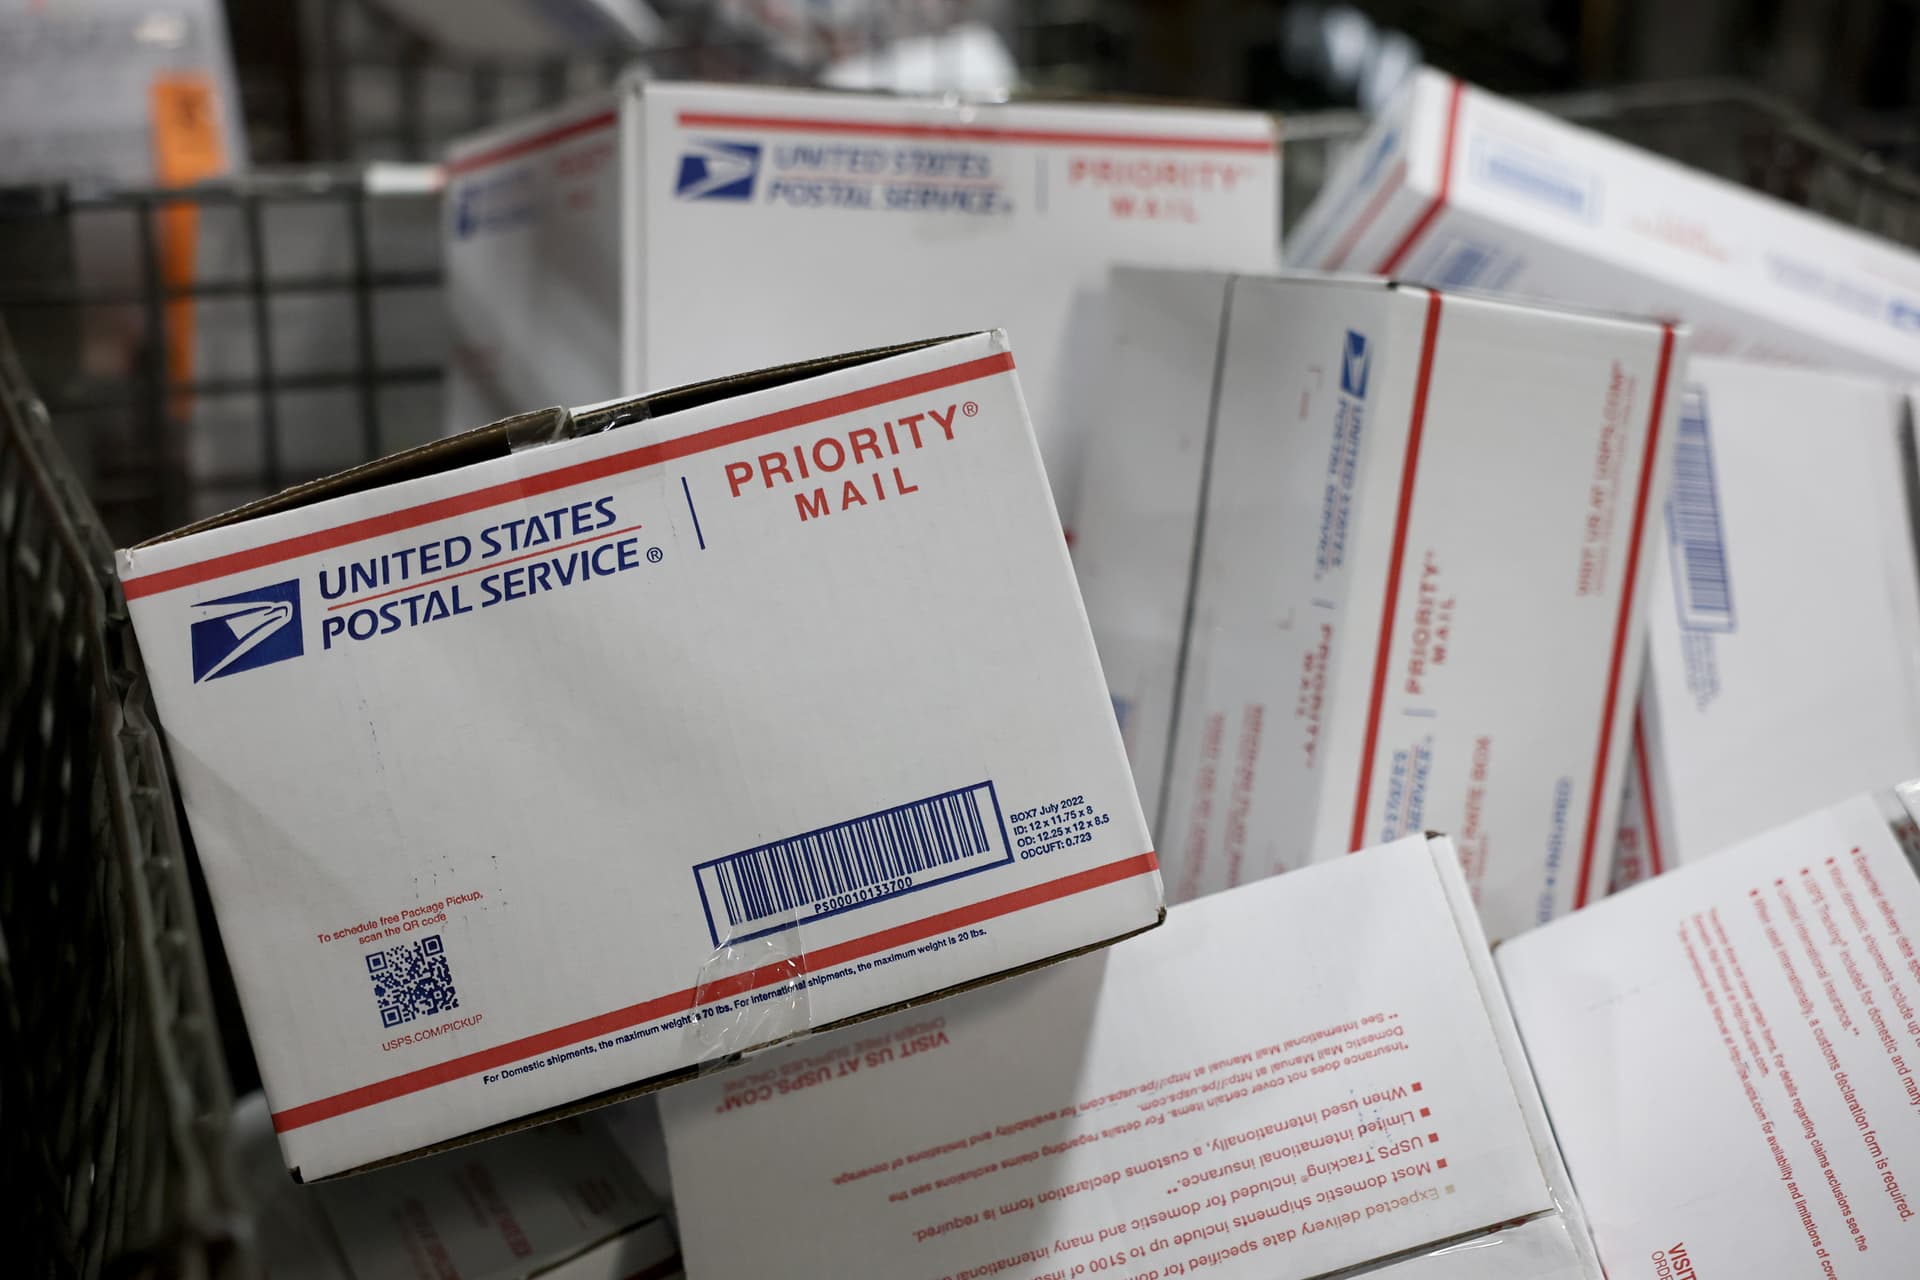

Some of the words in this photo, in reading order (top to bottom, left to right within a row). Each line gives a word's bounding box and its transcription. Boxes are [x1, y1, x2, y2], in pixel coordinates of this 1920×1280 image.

[1069, 157, 1257, 190] PRIORITY
[885, 186, 1016, 216] SERVICE
[724, 401, 978, 498] PRIORITY®
[794, 467, 919, 522] MAIL
[319, 535, 472, 600] UNITED
[480, 496, 617, 560] STATES
[322, 592, 473, 650] POSTAL
[480, 537, 663, 608] SERVICE®
[1406, 549, 1438, 694] PRIORITY
[1010, 808, 1037, 823] BOX7
[1040, 804, 1059, 815] July
[1061, 795, 1084, 809] 2022
[1014, 826, 1028, 836] ID:
[1029, 821, 1042, 831] 12
[1051, 810, 1077, 825] 11.75
[1086, 806, 1093, 815] 8
[1017, 837, 1036, 847] OD:
[1037, 827, 1063, 842] 12.25
[1073, 821, 1085, 831] 12
[1087, 820, 1093, 828] x
[1094, 814, 1110, 826] 8.5
[1020, 840, 1065, 860] ODCUFT:
[1065, 832, 1092, 847] 0.723
[814, 877, 913, 914] PS00010133700
[317, 934, 331, 944] To
[333, 921, 378, 940] schedule
[380, 914, 400, 925] free
[401, 901, 444, 921] Package
[359, 932, 383, 944] scan
[385, 926, 401, 936] the
[403, 920, 420, 933] QR
[422, 912, 446, 928] code
[483, 1074, 499, 1085] For
[501, 1059, 546, 1079] Domestic
[547, 1045, 597, 1067] shipments,
[599, 1040, 614, 1049] the
[615, 1026, 660, 1046] maximum
[661, 1014, 691, 1032] weight
[702, 1008, 714, 1019] 70
[716, 1004, 733, 1014] lbs.
[734, 997, 750, 1009] For
[750, 981, 806, 1005] international
[808, 965, 857, 990] shipments,
[857, 962, 872, 973] the
[873, 948, 916, 967] maximum
[917, 938, 948, 955] weight
[948, 935, 957, 945] is
[958, 931, 969, 943] 20
[970, 929, 987, 938] lbs.
[382, 1013, 483, 1052] USPS.COM/PICKUP
[899, 1031, 950, 1058] VISIT
[1345, 1025, 1403, 1048] Domestic
[865, 1048, 894, 1068] US
[1270, 1052, 1315, 1073] Manual
[1316, 1044, 1343, 1060] Mail
[837, 1056, 860, 1077] AT
[1255, 1066, 1267, 1077] at
[716, 1066, 832, 1114] USPS.COM
[1136, 1071, 1253, 1111] http://pe.usps.com.
[1361, 1085, 1407, 1106] When
[1834, 1071, 1869, 1130] declaration
[1320, 1099, 1358, 1120] used
[1356, 1110, 1415, 1137] Limited
[1206, 1111, 1317, 1151] internationally,
[1862, 1130, 1882, 1158] form
[1192, 1146, 1202, 1156] a
[1258, 1128, 1354, 1167] international
[1377, 1136, 1423, 1159] USPS
[1766, 1135, 1792, 1180] availability
[1124, 1150, 1189, 1177] customs
[1390, 1161, 1431, 1182] Most
[1874, 1156, 1888, 1169] is
[1036, 1170, 1121, 1203] declaration
[1229, 1173, 1296, 1203] included
[1315, 1174, 1387, 1202] domestic
[1786, 1181, 1803, 1200] and
[1810, 1139, 1830, 1168] claims
[1823, 1168, 1851, 1216] exclusions
[1845, 1217, 1860, 1235] see
[1854, 1234, 1867, 1251] the
[1880, 1170, 1914, 1222] required.
[981, 1208, 996, 1220] is
[998, 1197, 1034, 1215] form
[1205, 1194, 1226, 1208] for
[1232, 1196, 1311, 1227] shipments
[1364, 1188, 1438, 1218] Expected
[911, 1213, 979, 1243] required.
[1130, 1201, 1200, 1230] domestic
[1301, 1210, 1360, 1235] delivery
[1794, 1199, 1822, 1247] limitations
[1053, 1233, 1094, 1253] many
[1098, 1223, 1126, 1242] and
[1149, 1238, 1169, 1252] up
[1173, 1220, 1229, 1245] include
[1262, 1228, 1296, 1246] date
[1088, 1251, 1126, 1272] $100
[1129, 1245, 1146, 1258] to
[1188, 1239, 1258, 1271] specified
[1815, 1248, 1829, 1258] of
[1070, 1263, 1085, 1279] of
[1163, 1262, 1184, 1277] for
